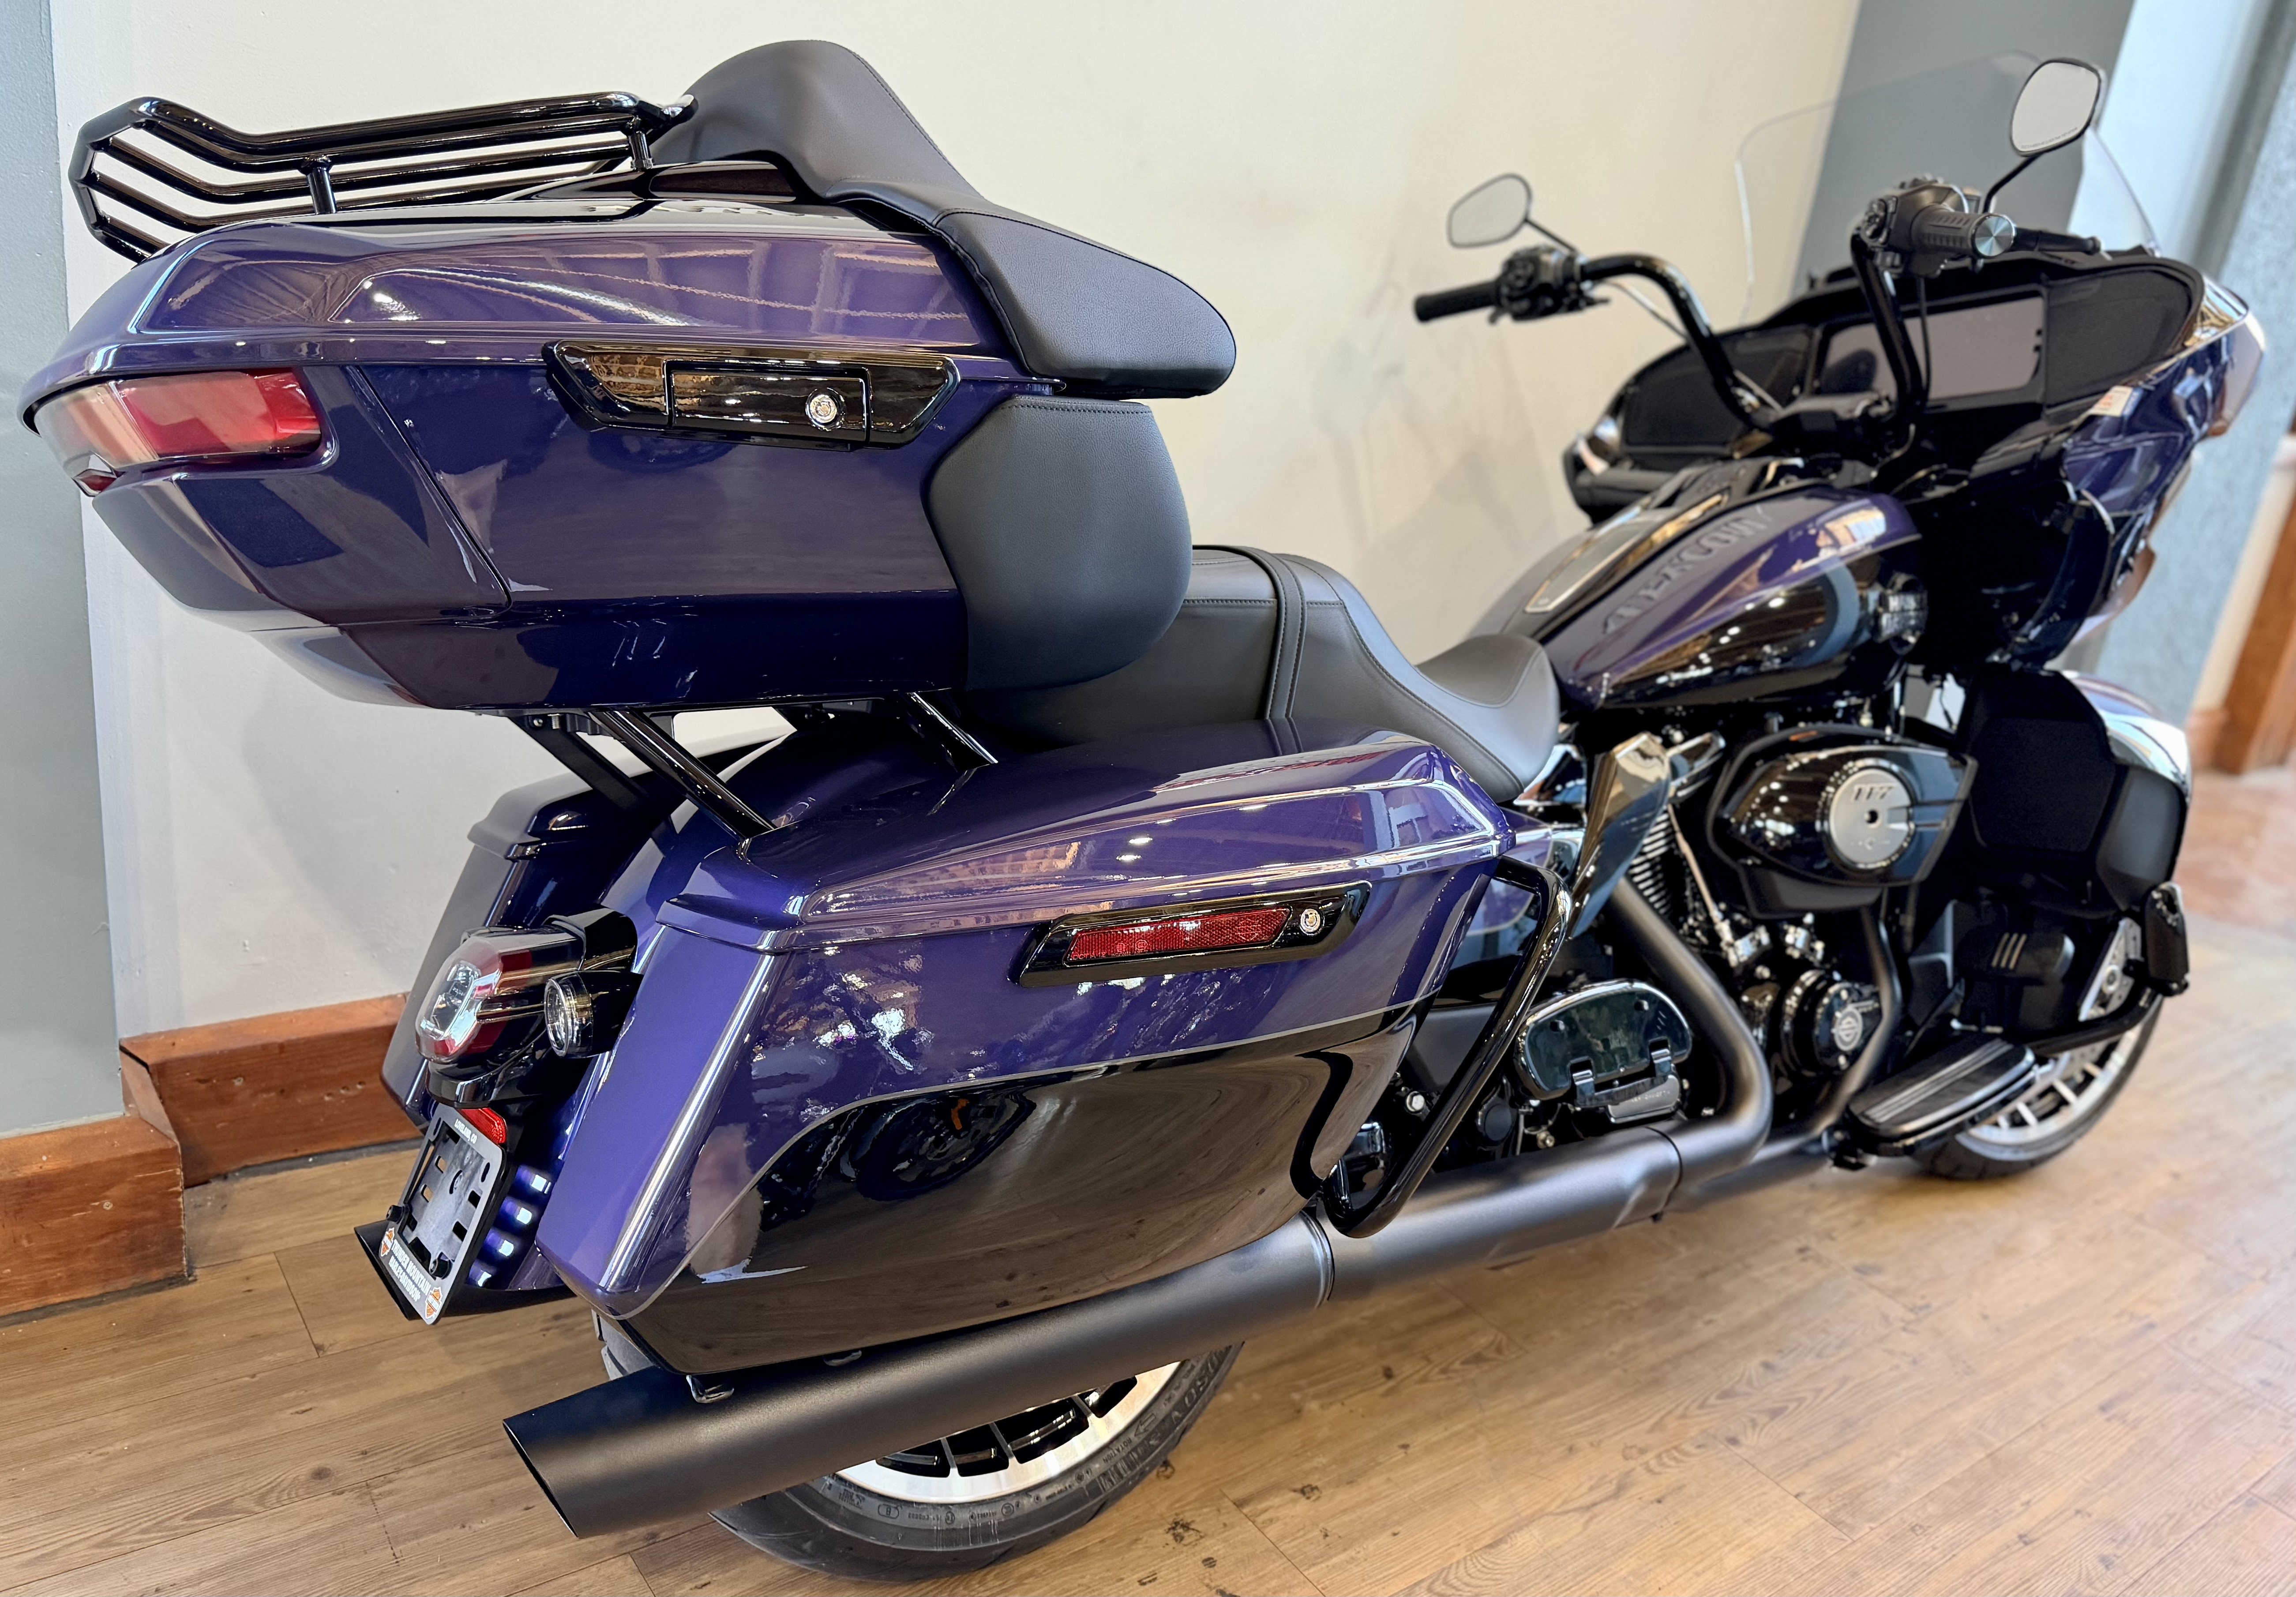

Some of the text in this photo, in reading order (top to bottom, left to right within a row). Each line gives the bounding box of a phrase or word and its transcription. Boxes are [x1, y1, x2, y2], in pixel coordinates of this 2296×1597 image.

[471, 1133, 477, 1144] CO
[391, 1239, 431, 1296] THUNDER MOUNTAIN
[1103, 1437, 1132, 1464] ROTATION
